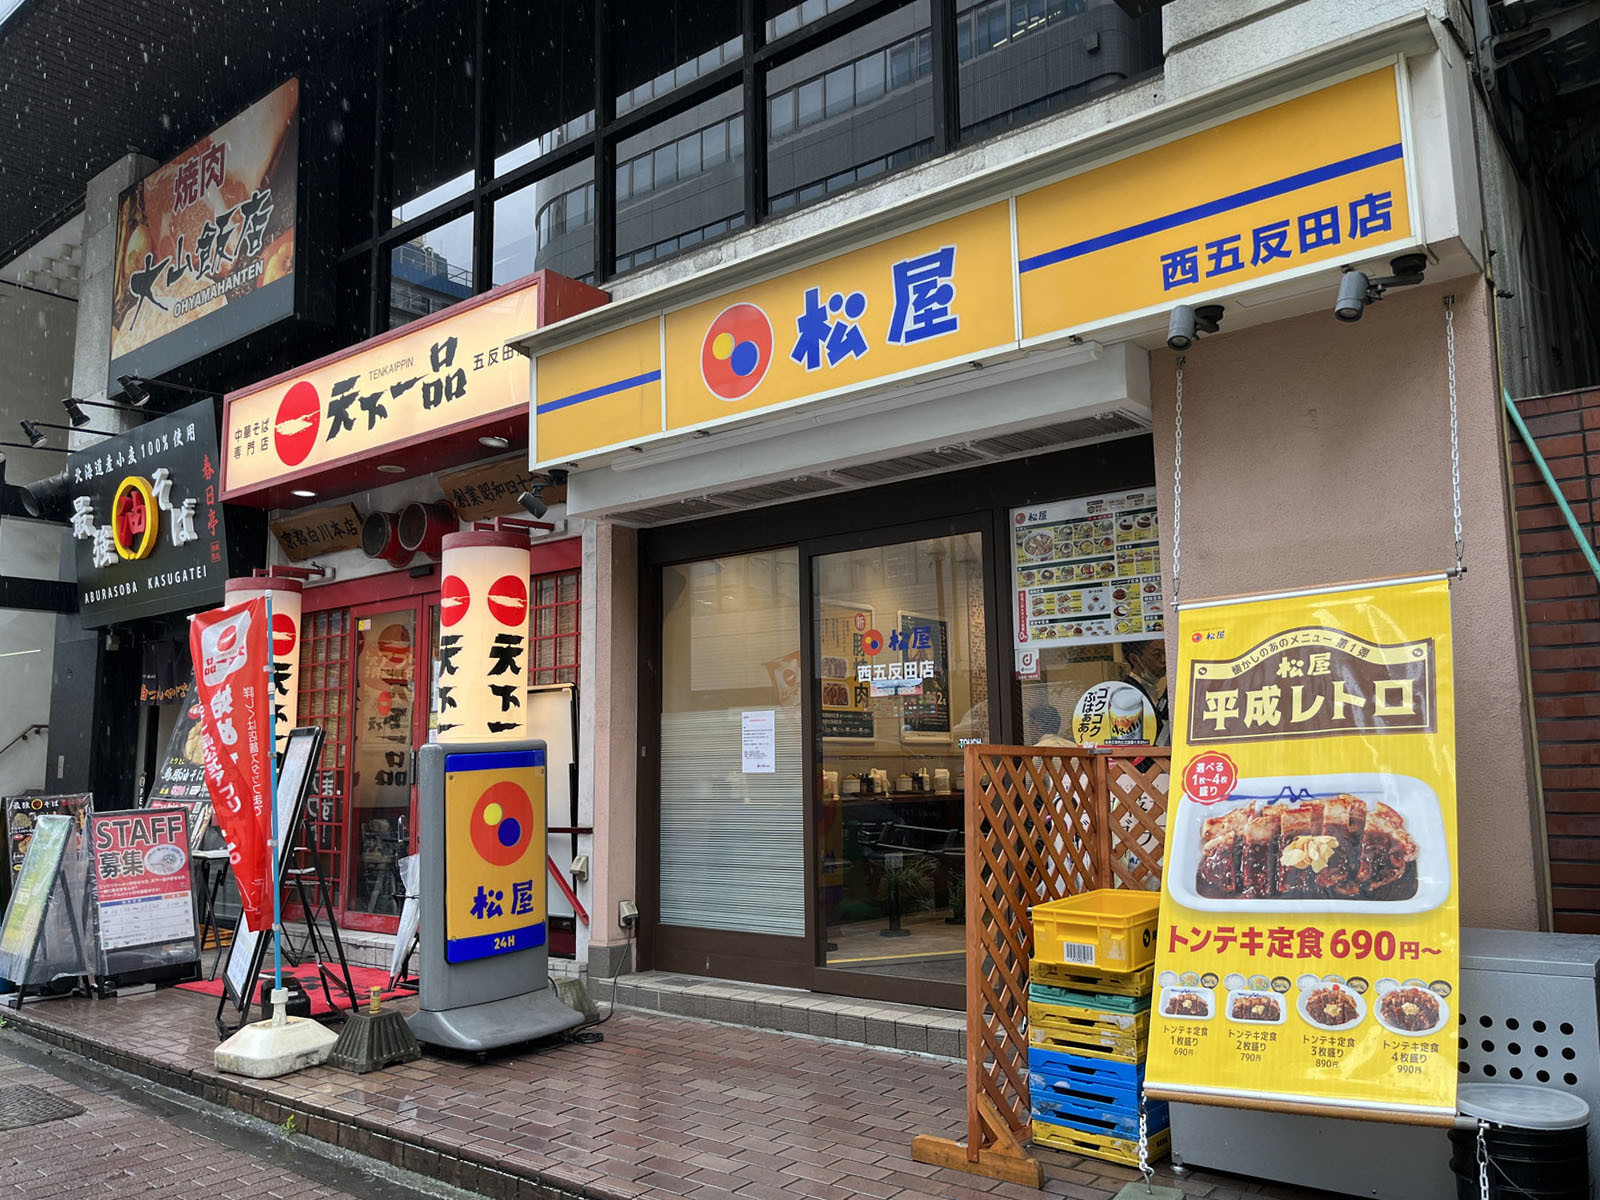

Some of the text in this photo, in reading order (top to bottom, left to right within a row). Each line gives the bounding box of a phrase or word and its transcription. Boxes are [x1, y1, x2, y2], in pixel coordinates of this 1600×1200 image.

[172, 143, 230, 214] 焼肉
[1160, 191, 1393, 291] 西五反田店
[173, 260, 264, 318] OHYAMAHANTEN
[789, 244, 960, 373] 松屋
[368, 356, 414, 381] TENKAIPPIN
[473, 343, 520, 371] 五反田
[326, 336, 468, 442] 天下一品
[234, 418, 270, 443] 中華そば
[202, 454, 220, 536] 春日亭
[84, 564, 207, 604] ABURASOBA KASUGATEI
[888, 626, 931, 651] 松屋
[857, 660, 935, 683] 西五反田店
[1276, 652, 1332, 678] 松屋
[1089, 686, 1111, 738] ゴクゴク
[1203, 679, 1416, 731] 平成レトロ
[1196, 762, 1224, 773] 選べる
[1199, 786, 1218, 797] 盛り
[96, 815, 183, 849] STAFF
[99, 849, 145, 880] 募集
[470, 879, 535, 920] 松屋
[493, 935, 516, 950] 24H
[1162, 1025, 1208, 1037] トンテキ定食
[1170, 1036, 1199, 1047] 1枚盛り
[1227, 1029, 1277, 1042] トンテキ定食
[1302, 1034, 1355, 1048] トンテキ定食
[1173, 1047, 1194, 1057] 690円
[1236, 1040, 1267, 1052] 2枚盛り
[1240, 1052, 1262, 1062] 790円
[1311, 1047, 1345, 1059] 3枚盛り
[1383, 1040, 1439, 1054] トンテキ定食
[1392, 1052, 1427, 1065] 4枚盛り
[1315, 1058, 1339, 1069] 890円
[1397, 1064, 1422, 1075] 990円
